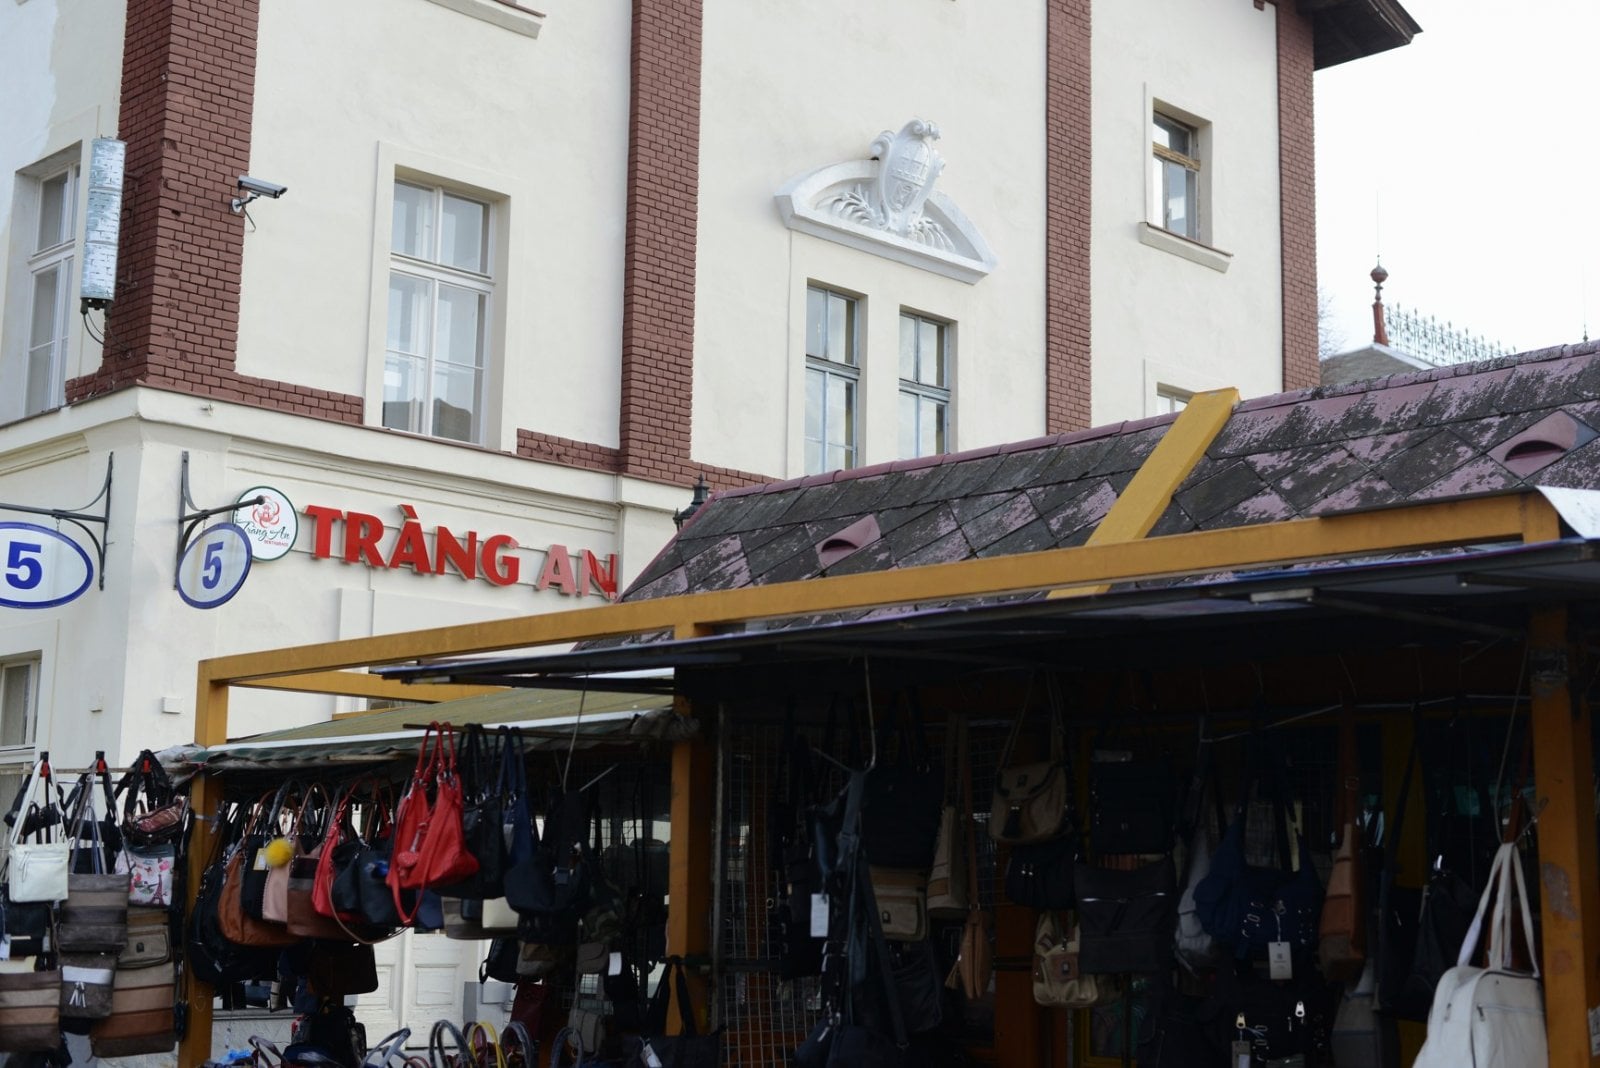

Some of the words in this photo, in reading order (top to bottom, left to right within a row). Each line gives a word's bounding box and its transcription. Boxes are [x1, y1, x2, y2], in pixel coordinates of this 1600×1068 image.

[6, 542, 42, 590] 5
[202, 542, 224, 589] 5
[304, 504, 520, 586] TRÀNG
[537, 543, 618, 600] AN
